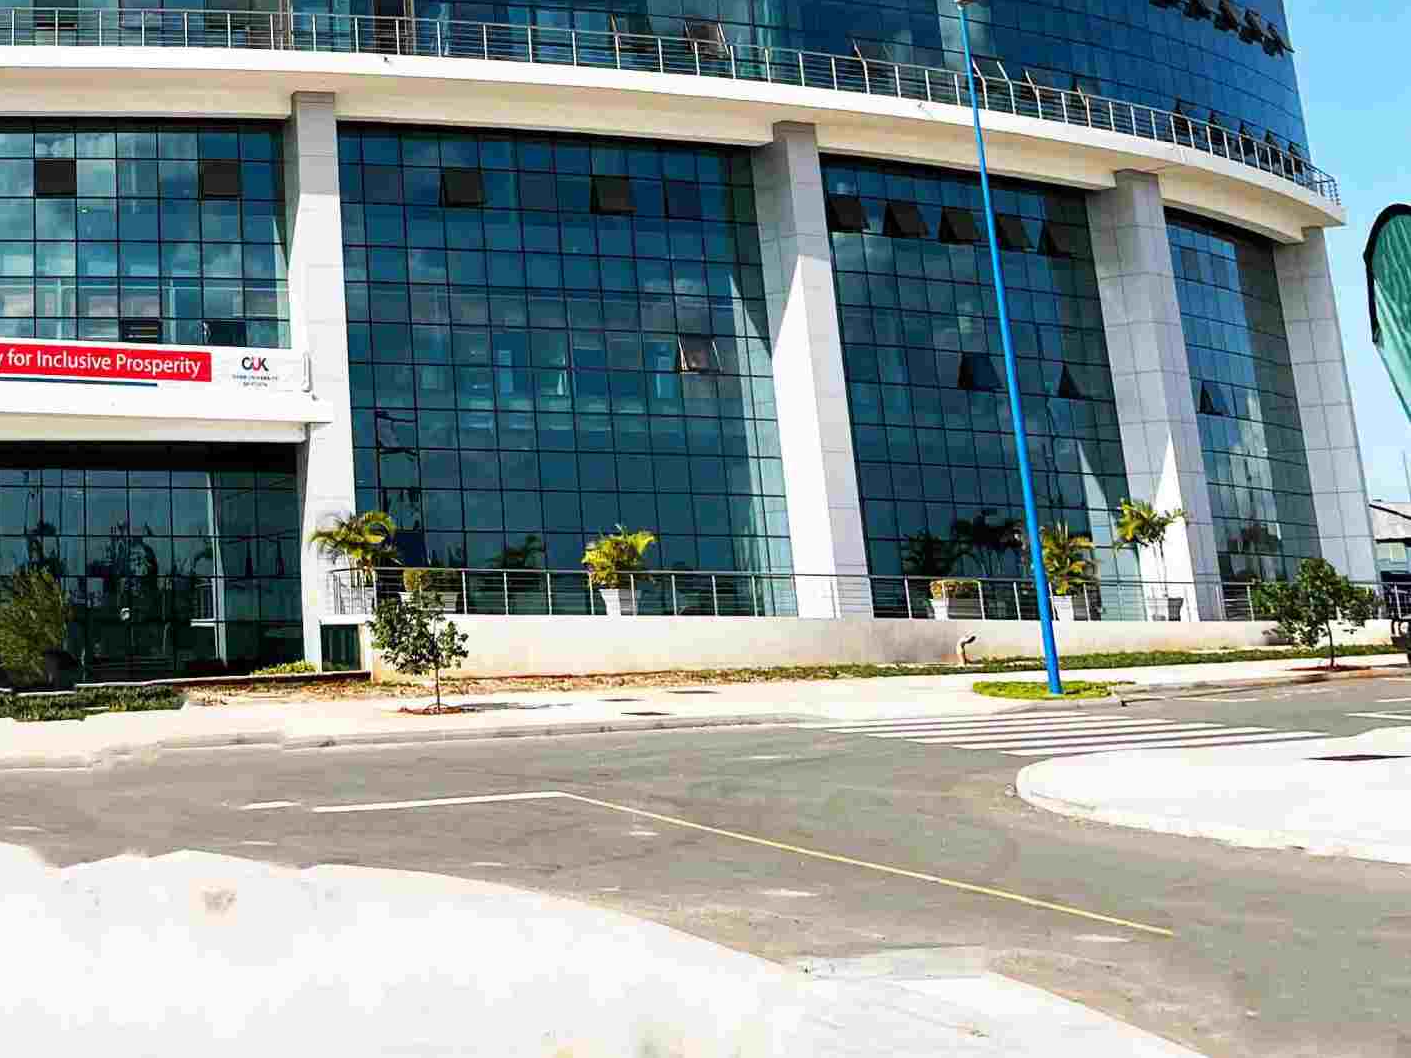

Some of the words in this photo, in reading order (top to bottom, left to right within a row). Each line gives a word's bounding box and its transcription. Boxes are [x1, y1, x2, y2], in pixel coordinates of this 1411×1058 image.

[7, 349, 32, 366] for
[37, 350, 111, 370] Inclusive
[116, 354, 201, 378] Prosperity
